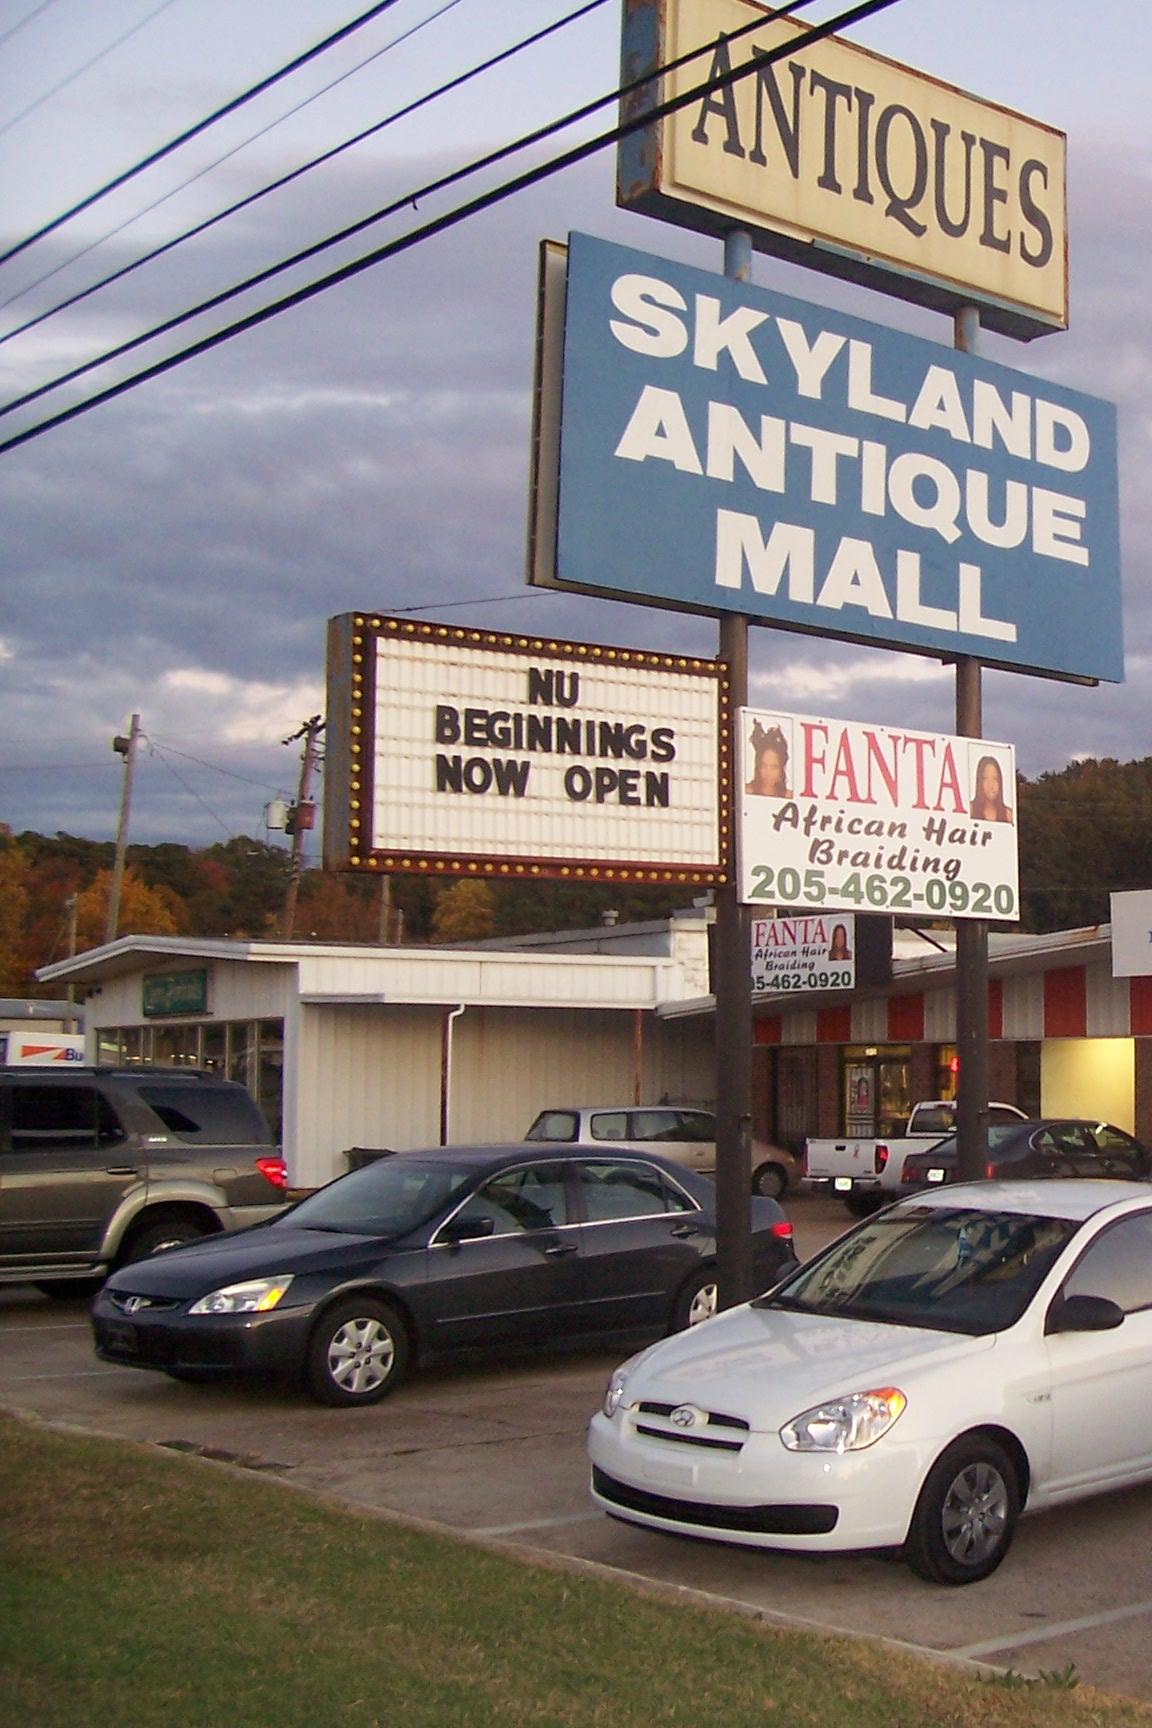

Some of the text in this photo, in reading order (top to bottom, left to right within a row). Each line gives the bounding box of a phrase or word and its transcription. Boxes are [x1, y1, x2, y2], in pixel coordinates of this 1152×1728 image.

[692, 31, 1054, 269] ANTIQUES
[609, 273, 1090, 473] SKYLAND
[614, 385, 1089, 567] ANTIQUE
[715, 508, 1018, 643] MALL
[528, 667, 580, 707] NU
[435, 705, 676, 763] BEGINNINGS
[435, 754, 670, 808] NOW OPEN
[800, 722, 969, 815] FANTA
[772, 801, 993, 848] African Hair
[808, 838, 962, 881] Braiding
[748, 865, 1014, 915] 205-462-0920
[754, 918, 828, 947] FANTA
[755, 946, 828, 961] African Hair
[765, 961, 816, 972] Braiding
